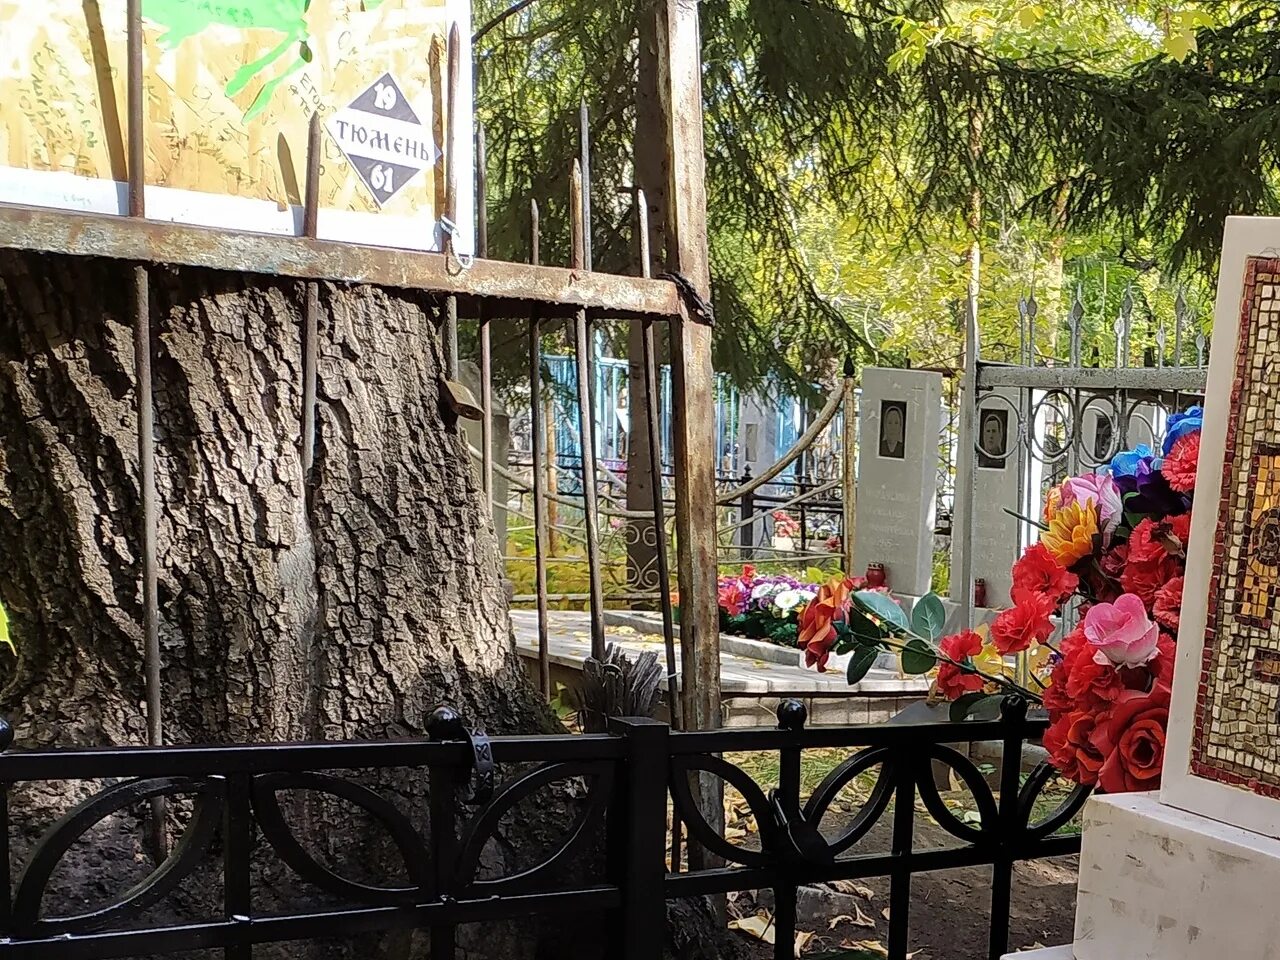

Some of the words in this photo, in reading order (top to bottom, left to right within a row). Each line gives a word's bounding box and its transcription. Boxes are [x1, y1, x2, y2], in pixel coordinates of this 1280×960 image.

[373, 82, 397, 111] 19
[336, 120, 429, 161] ТЮМЕНЬ
[370, 164, 394, 193] 61
